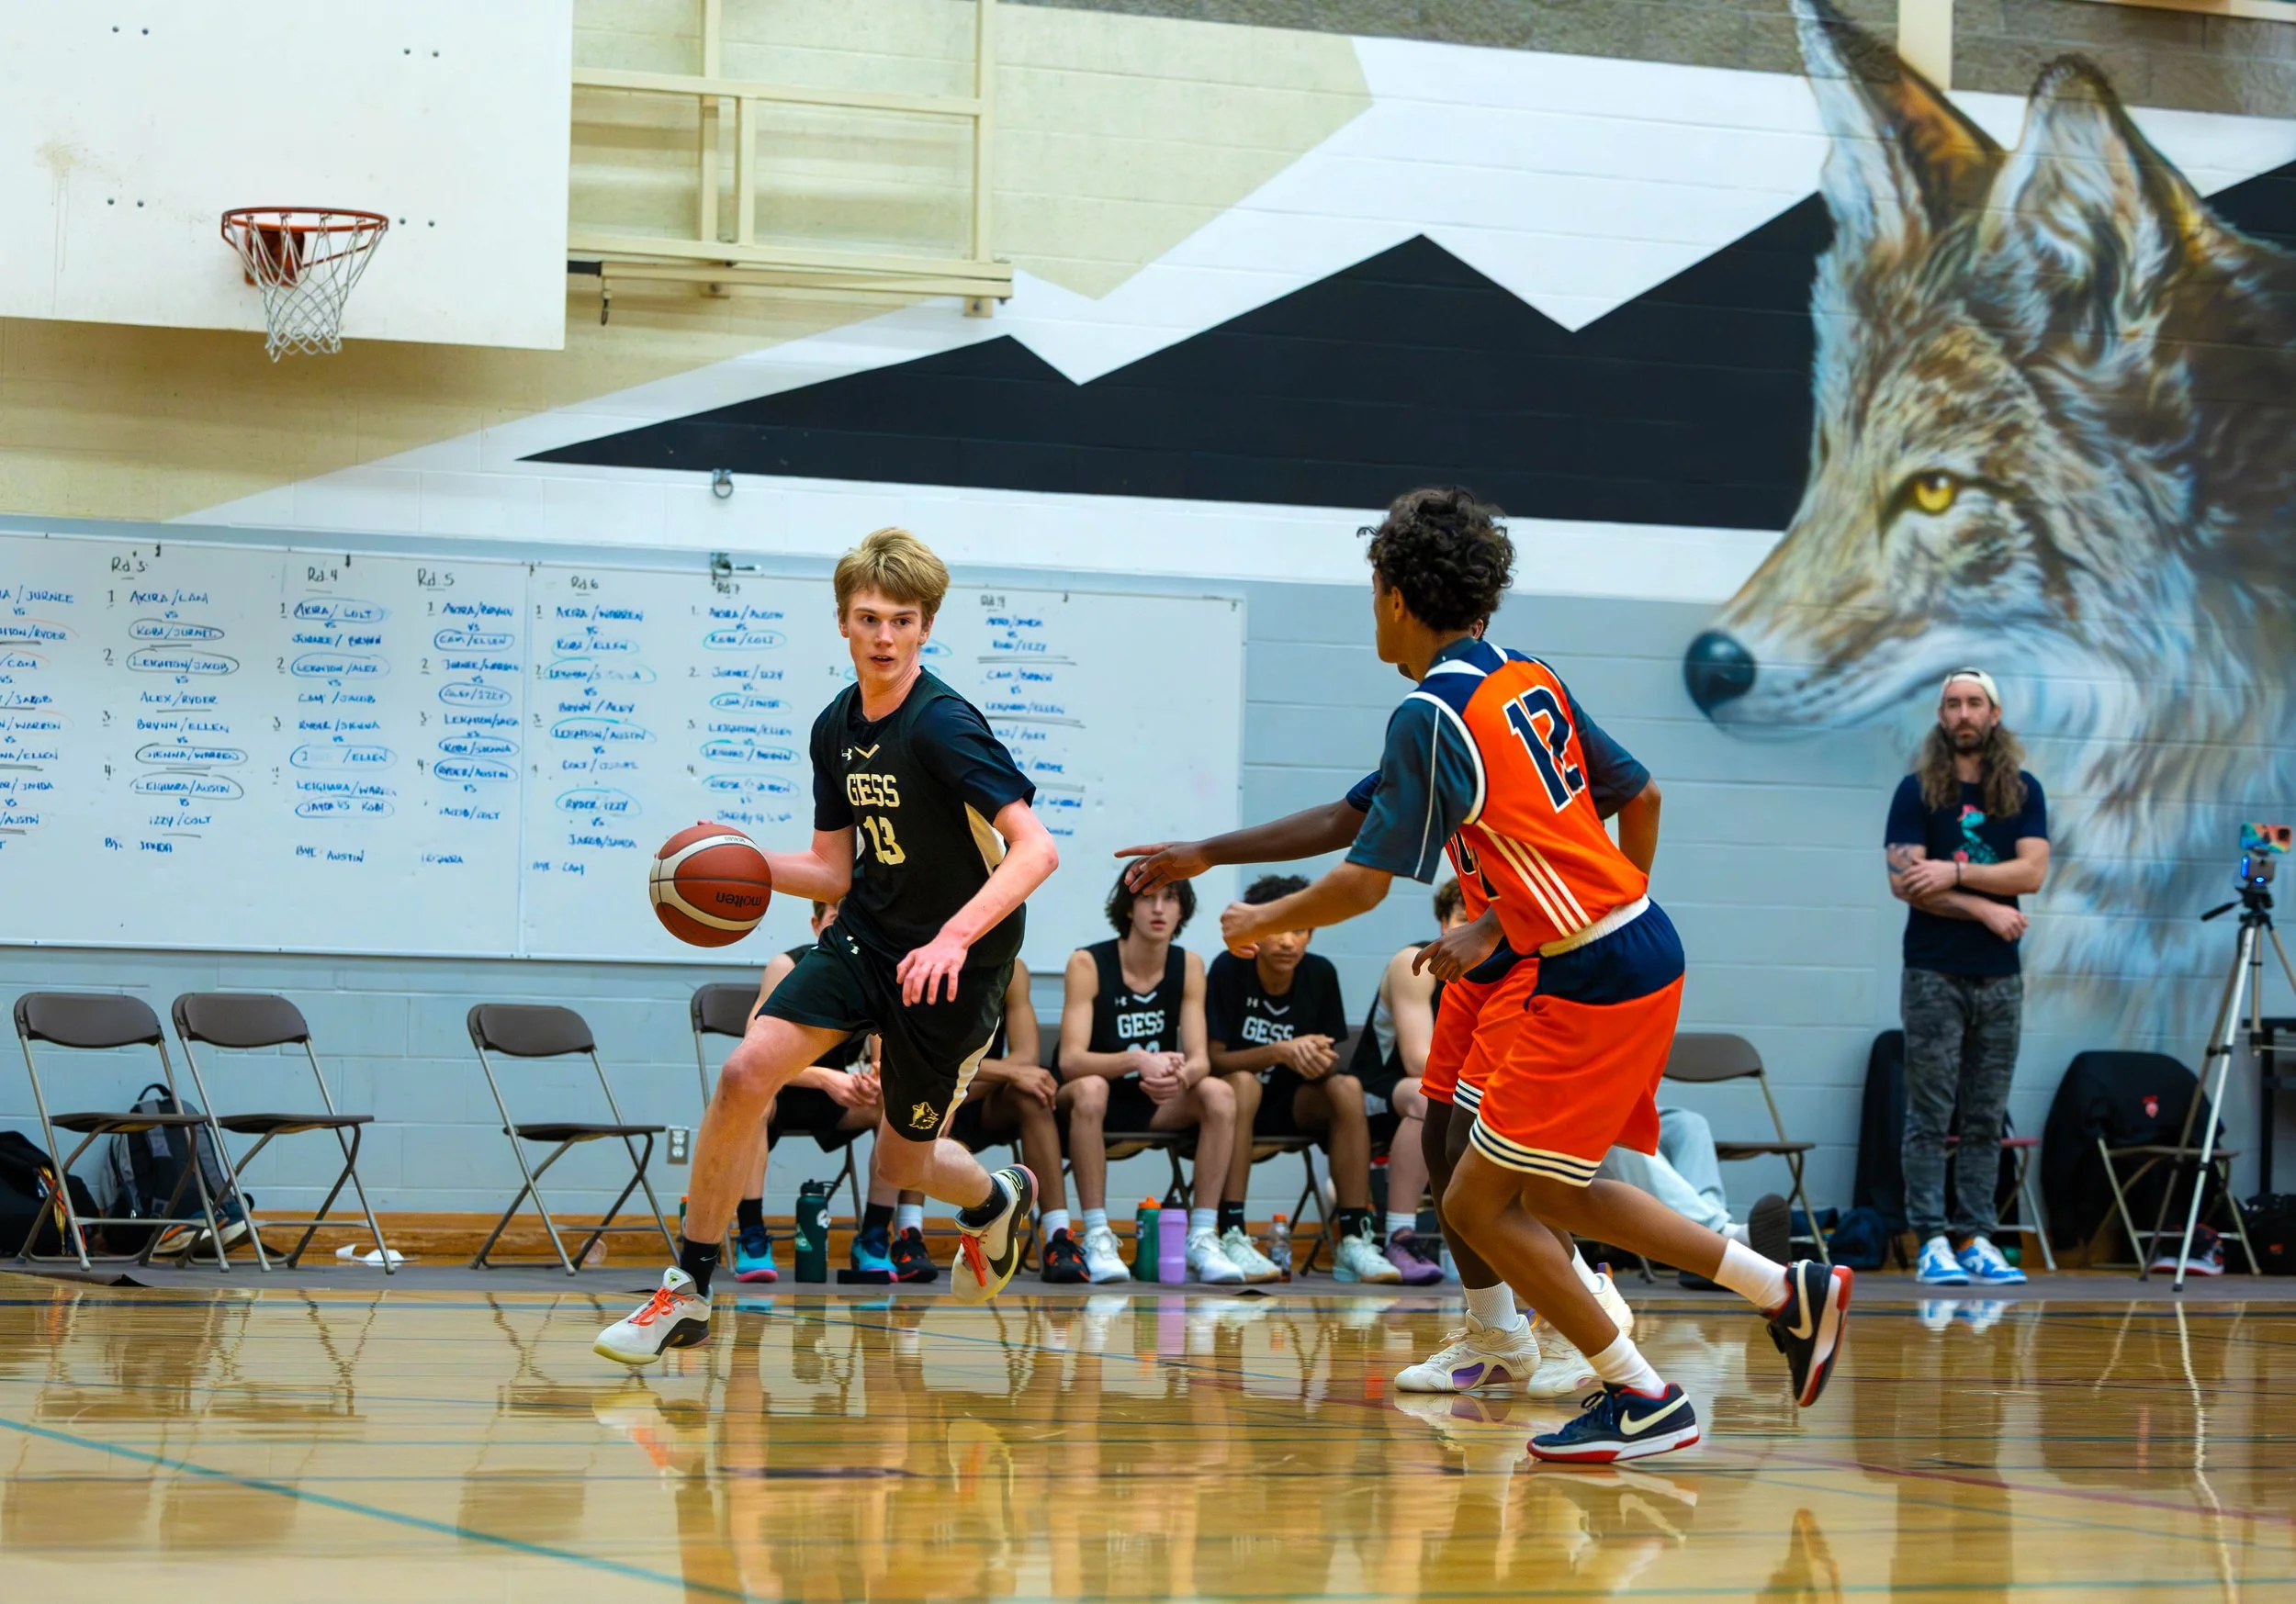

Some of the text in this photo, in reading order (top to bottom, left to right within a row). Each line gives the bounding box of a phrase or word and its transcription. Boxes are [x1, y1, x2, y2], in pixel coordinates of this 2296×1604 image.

[331, 568, 338, 581] 4
[1503, 684, 1587, 814] 12
[846, 773, 900, 807] GESS
[863, 815, 906, 865] 13
[716, 892, 761, 908] molten
[1117, 1010, 1165, 1038] GESS
[1242, 1015, 1295, 1044] GESS
